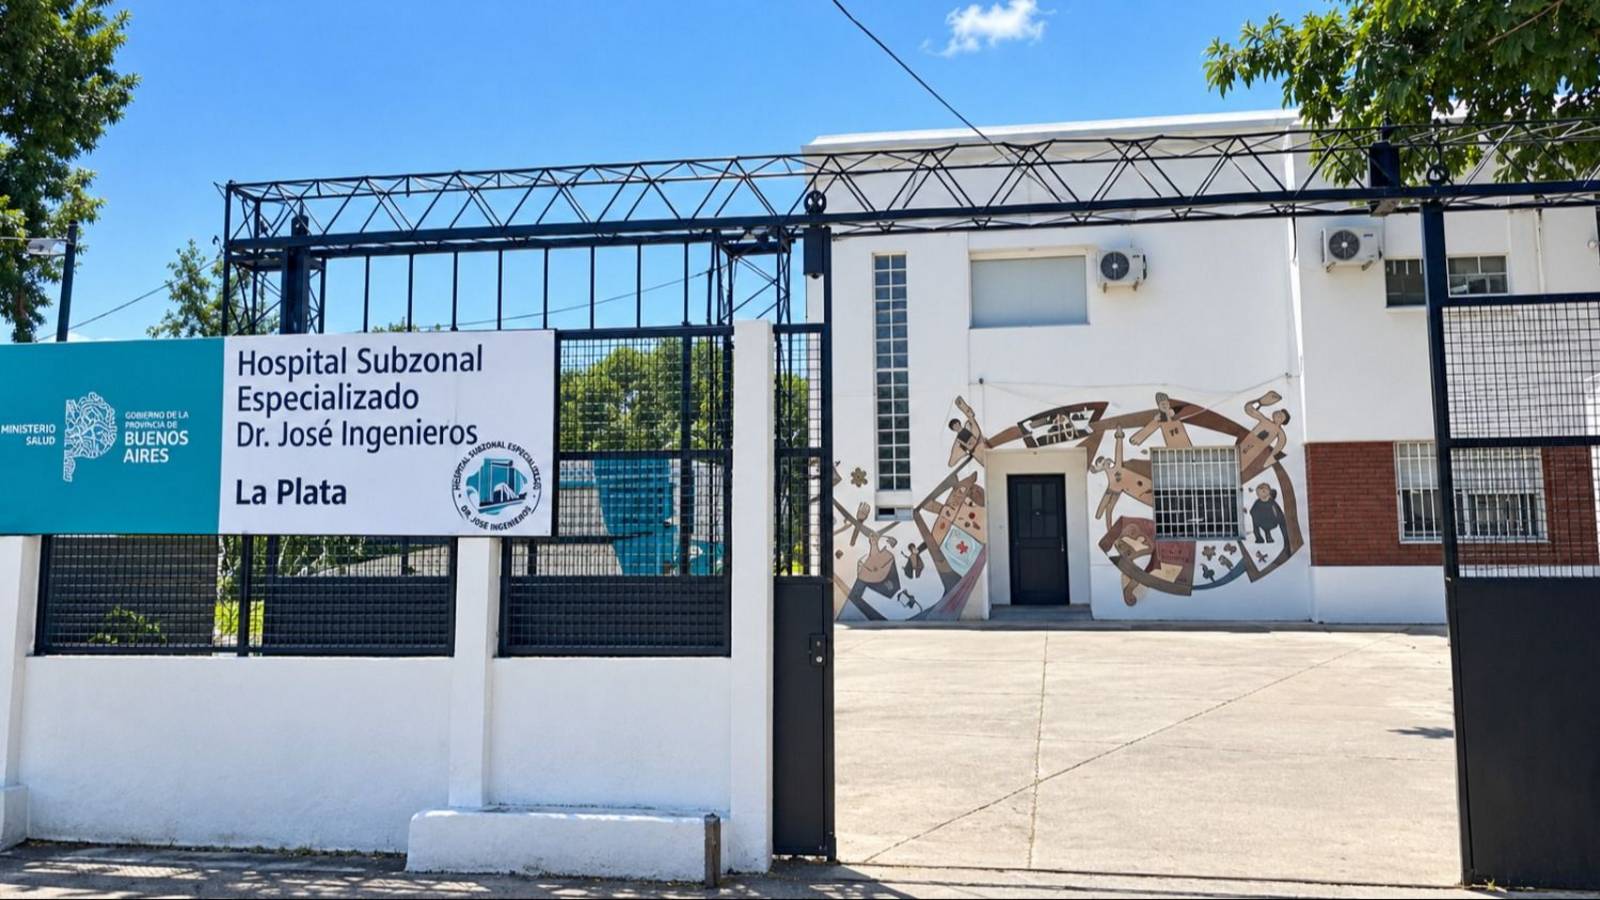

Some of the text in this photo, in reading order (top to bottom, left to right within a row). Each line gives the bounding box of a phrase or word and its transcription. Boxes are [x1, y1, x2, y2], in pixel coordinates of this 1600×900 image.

[238, 344, 483, 382] Hospital Subzonal
[237, 382, 419, 418] Especializado
[125, 411, 189, 420] GOBIERNO DE LA
[0, 423, 56, 434] MINISTERIO
[125, 420, 178, 429] PROVINCIA DE
[25, 436, 56, 446] SALUD
[124, 430, 189, 446] BUENOS
[237, 418, 478, 453] Dr. José Ingenieros
[123, 447, 170, 464] AIRES
[235, 476, 347, 505] La Plata
